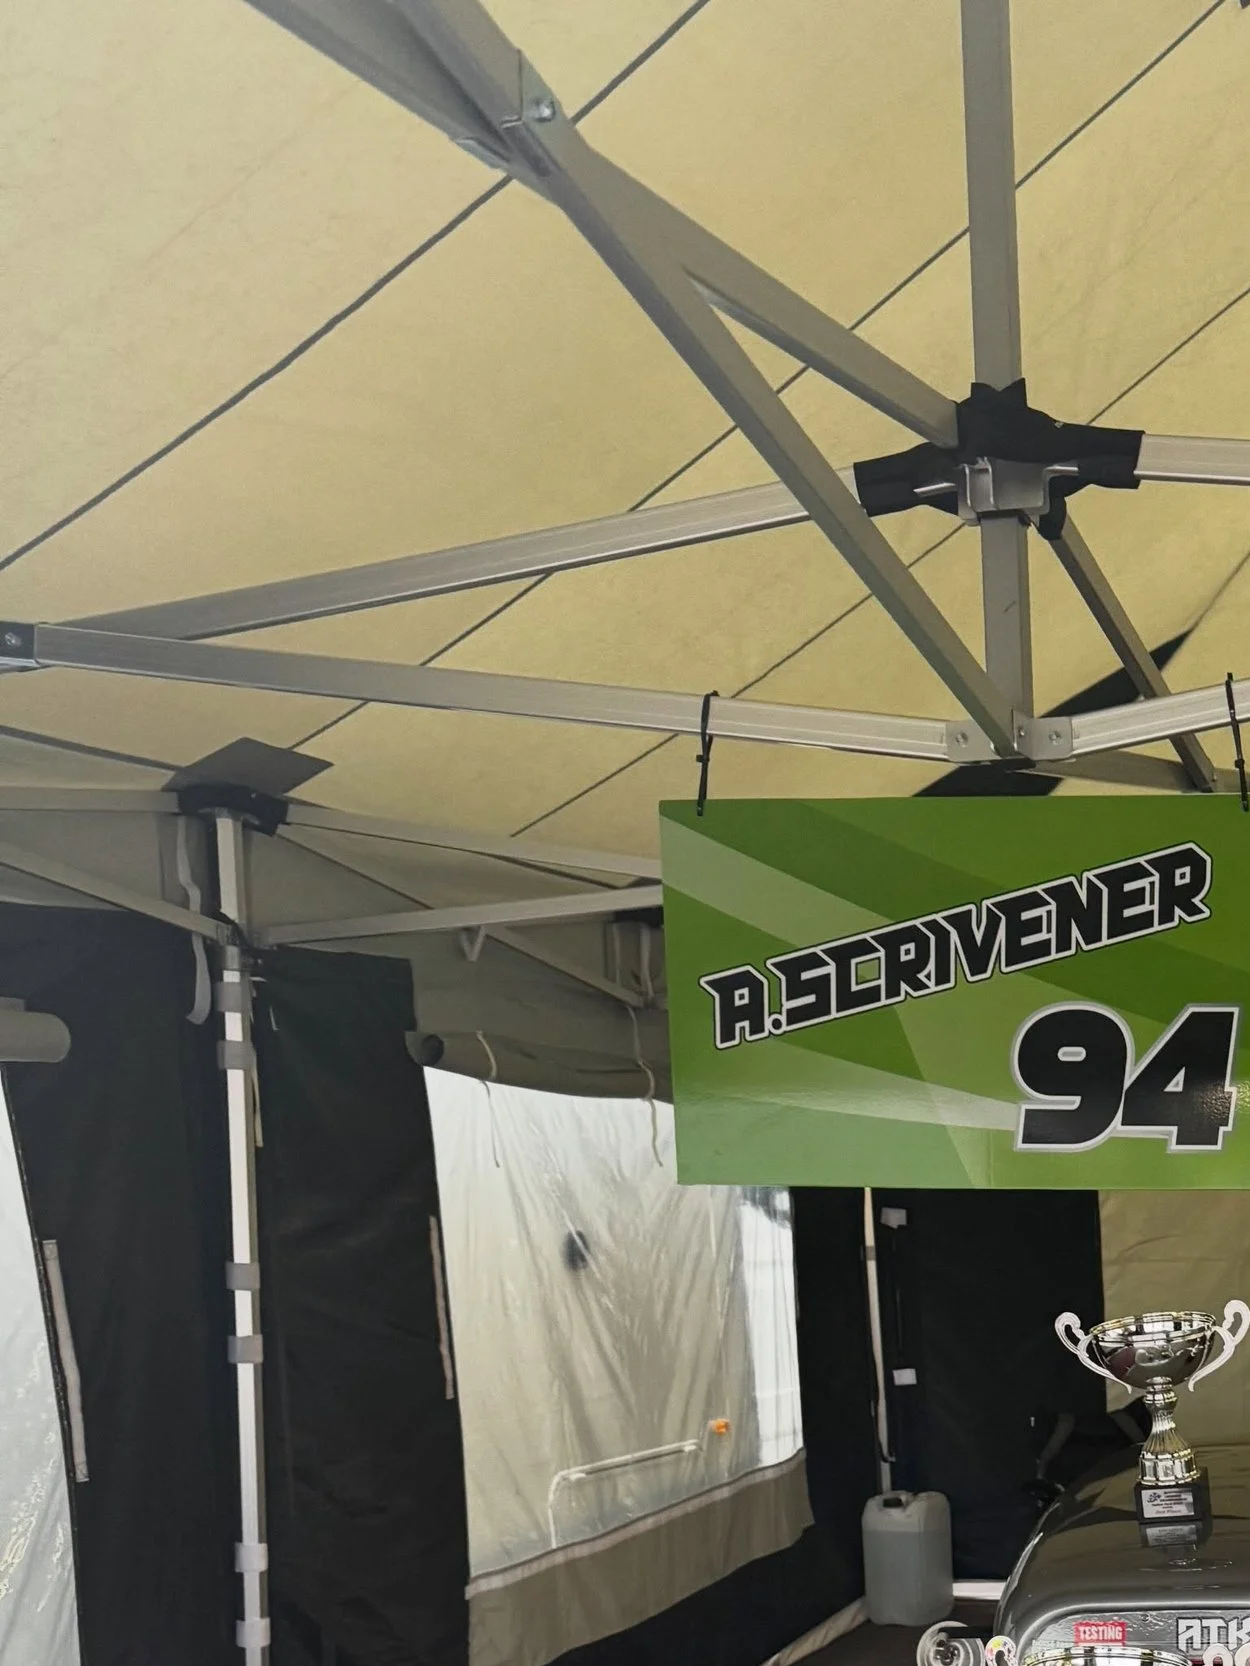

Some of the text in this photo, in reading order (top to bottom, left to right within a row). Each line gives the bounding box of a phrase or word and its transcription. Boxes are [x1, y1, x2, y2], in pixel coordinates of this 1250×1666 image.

[699, 841, 1213, 1051] A.SCRIVENER
[1011, 1001, 1241, 1154] 94
[1079, 1625, 1122, 1640] TESTING
